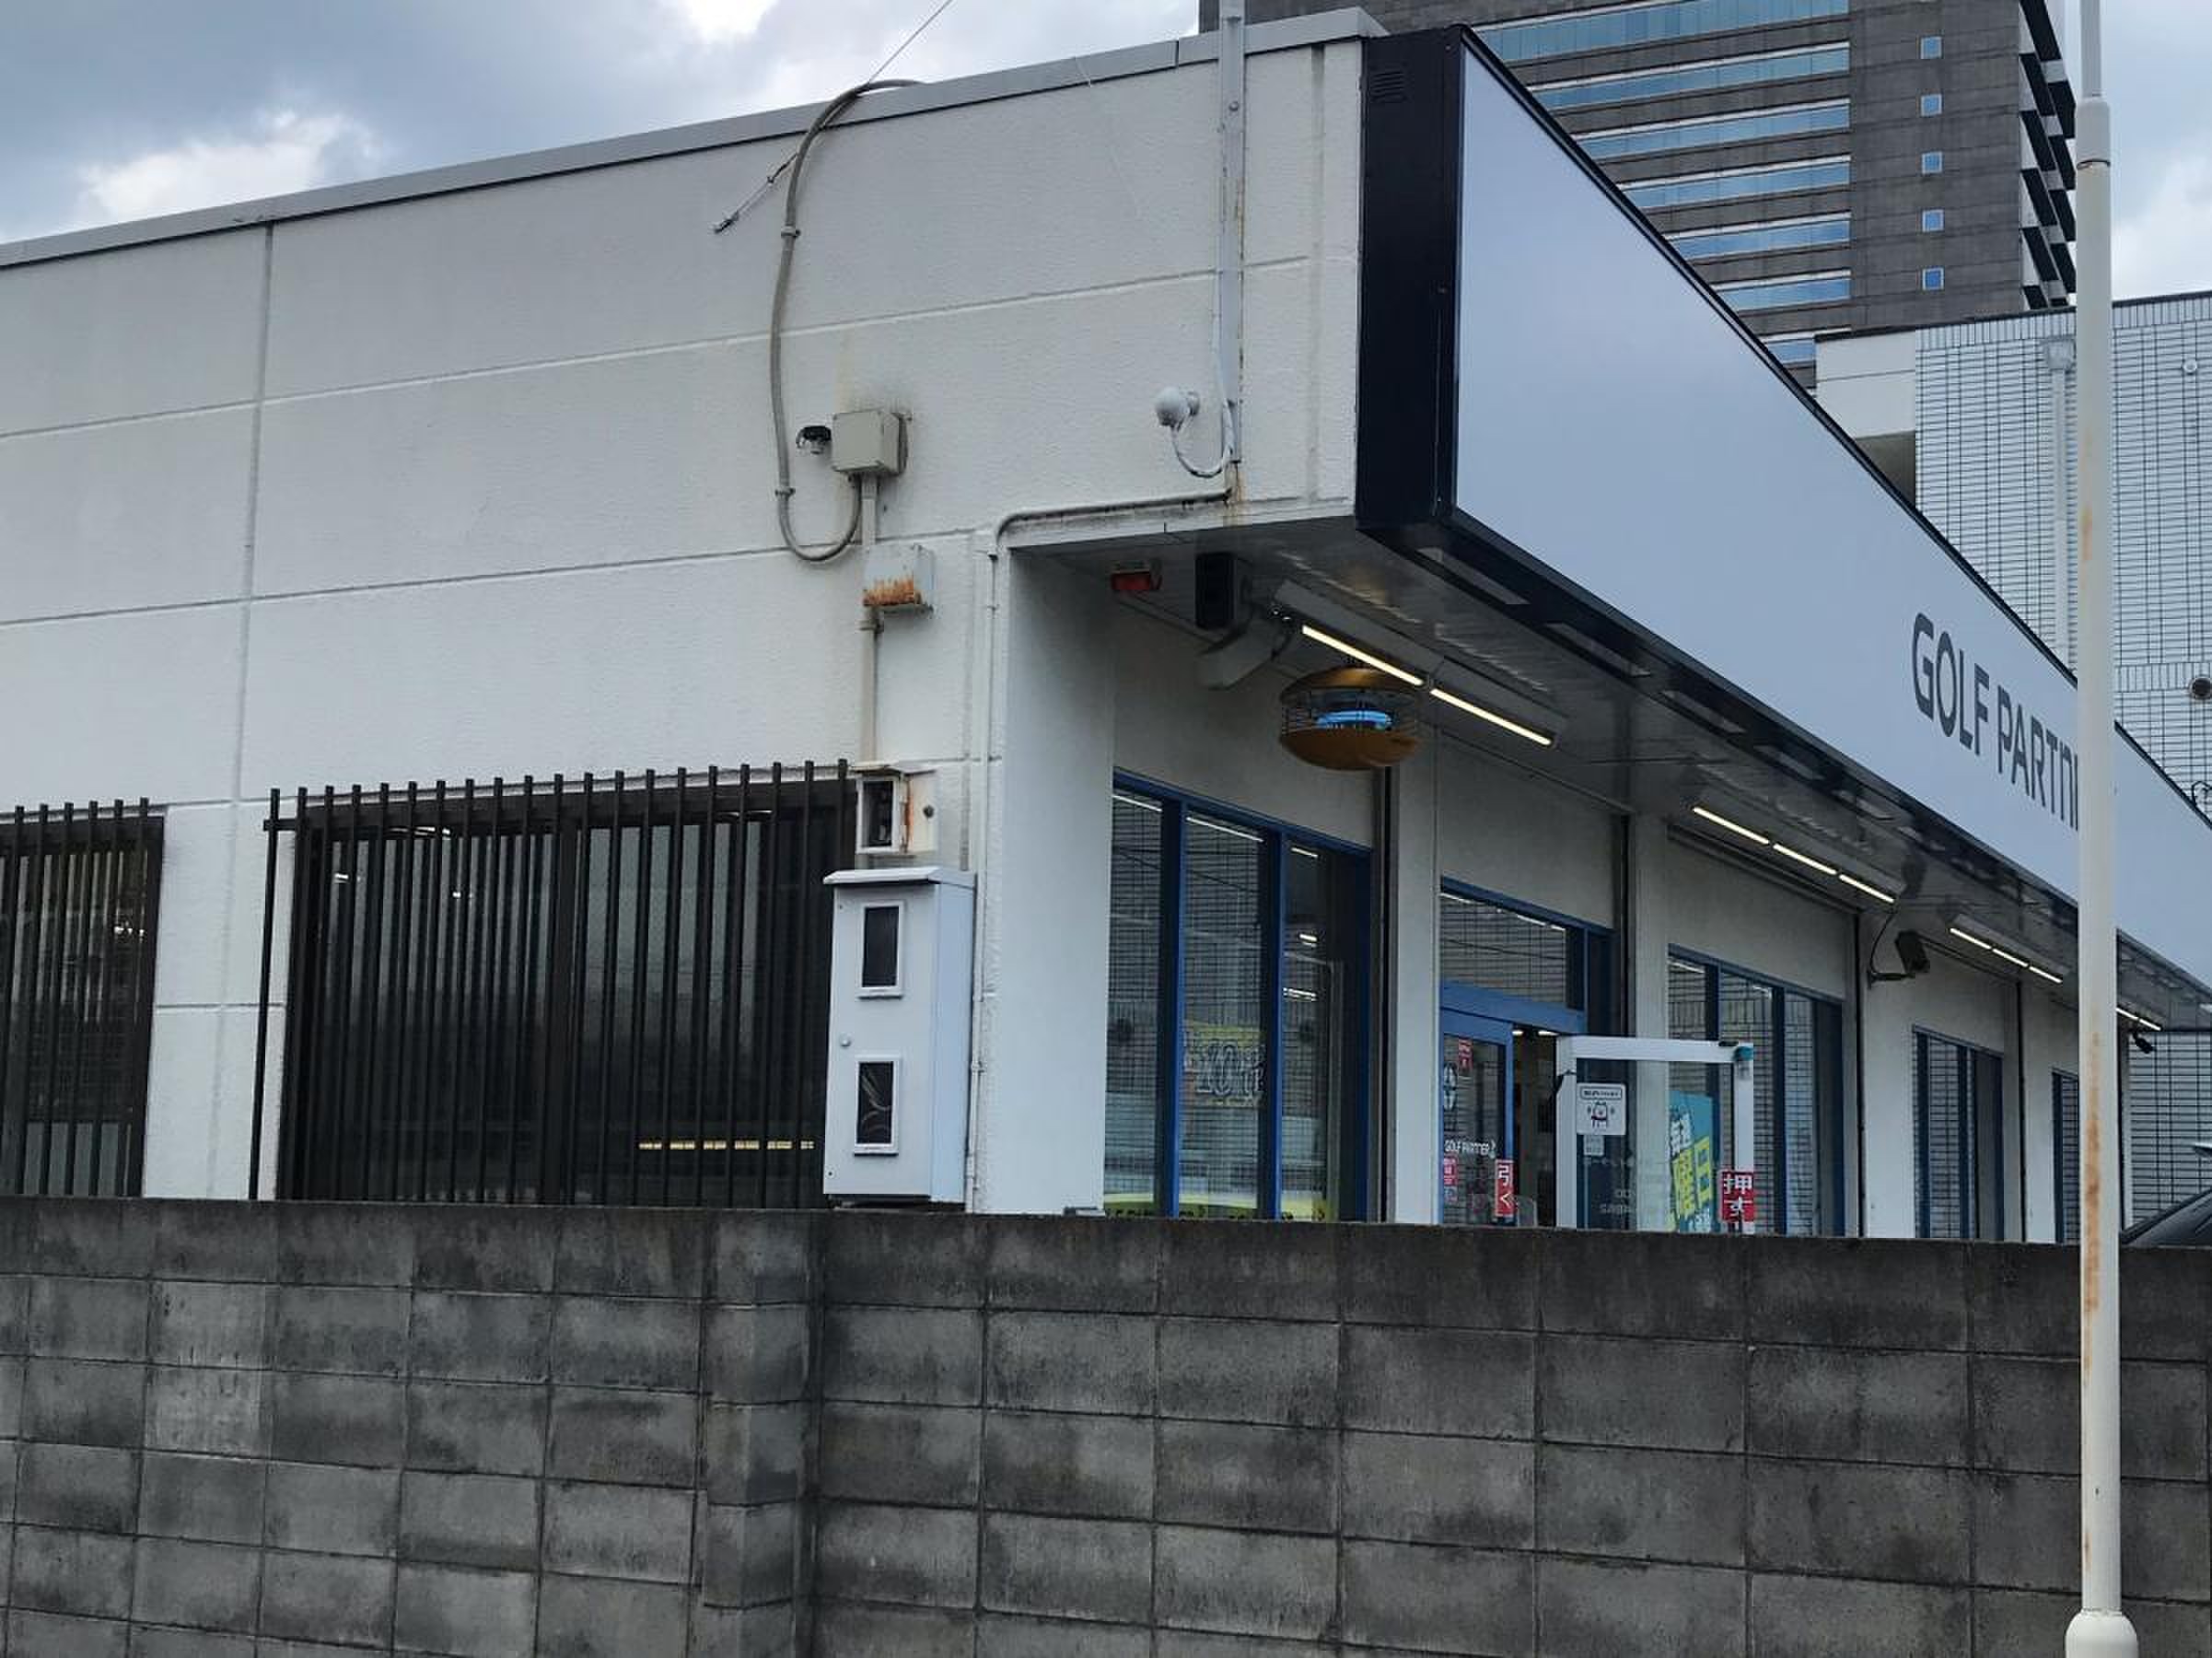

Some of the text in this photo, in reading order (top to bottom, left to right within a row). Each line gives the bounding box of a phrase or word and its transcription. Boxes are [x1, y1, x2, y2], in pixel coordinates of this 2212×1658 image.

[1912, 612, 2078, 831] GOLF PARTN
[1723, 1173, 1753, 1217] 押す
